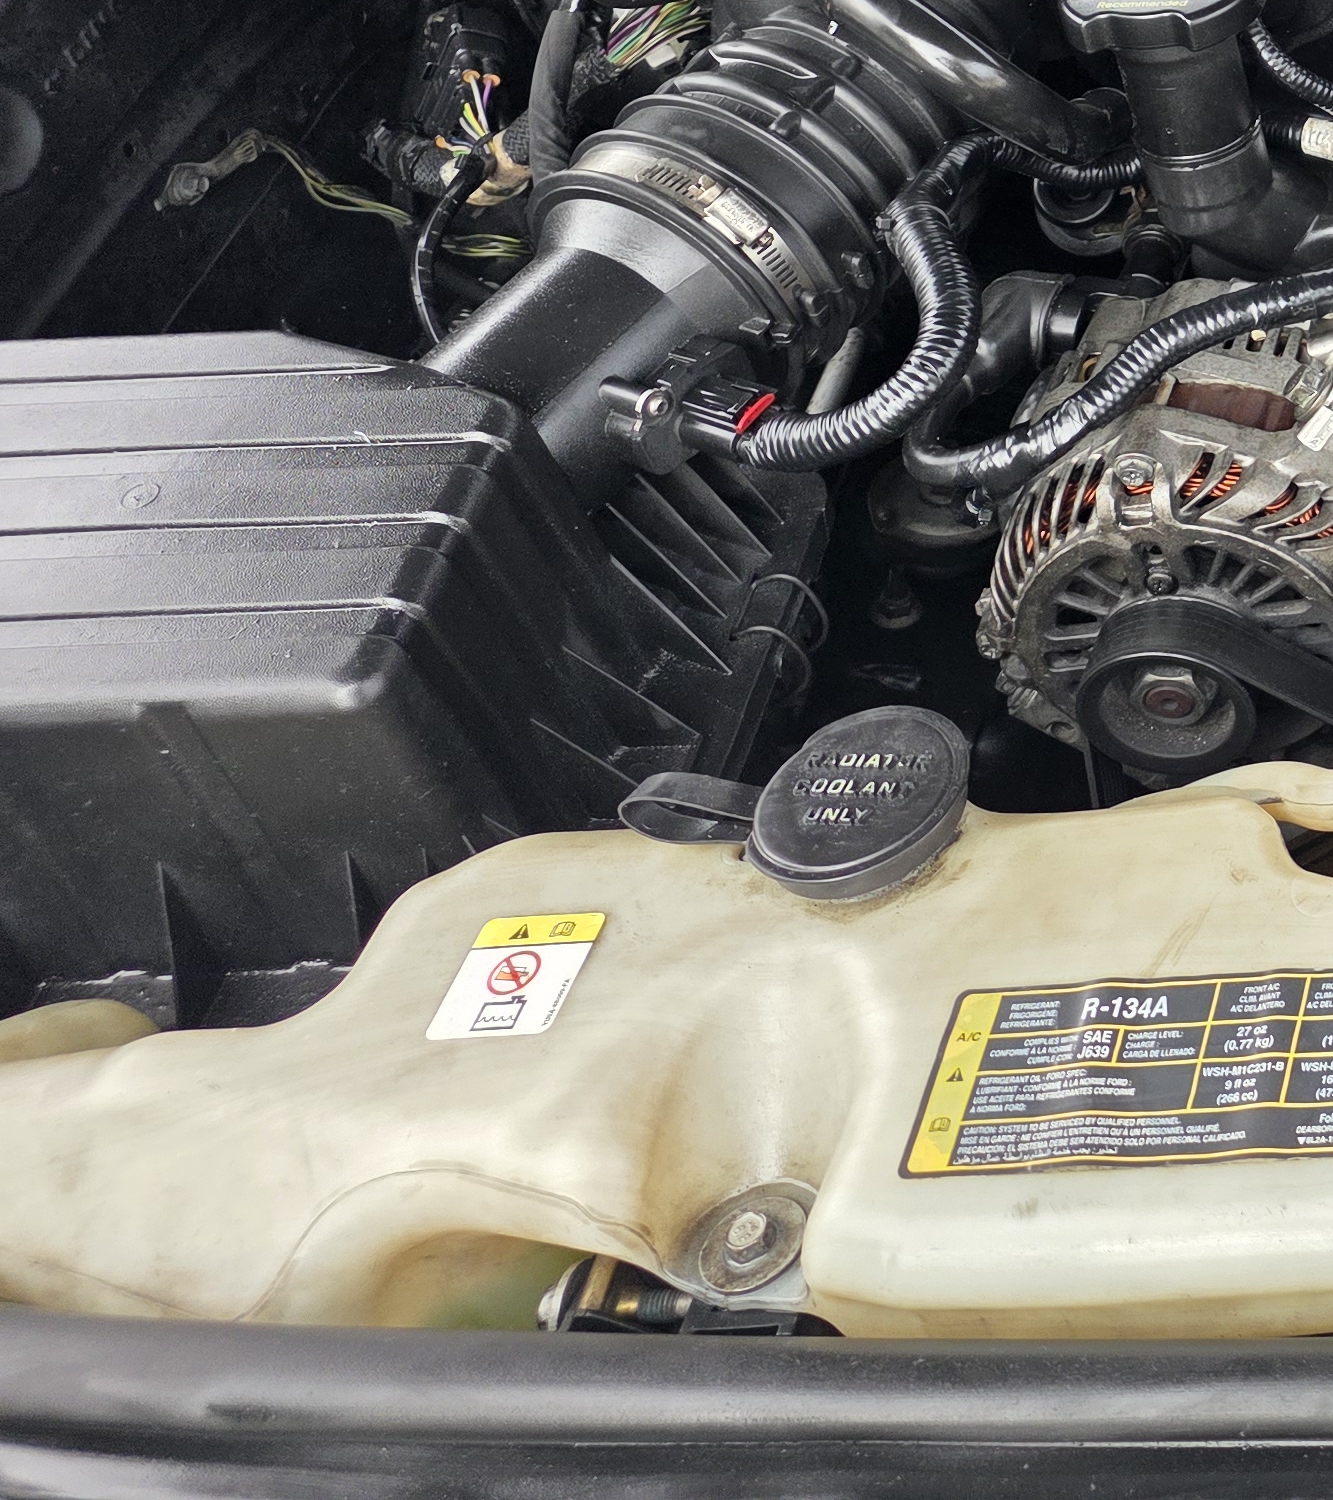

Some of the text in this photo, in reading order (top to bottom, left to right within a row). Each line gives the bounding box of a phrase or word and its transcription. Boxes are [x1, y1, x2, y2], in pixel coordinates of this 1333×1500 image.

[1096, 0, 1188, 10] Recommended
[1081, 996, 1168, 1020] R-134A
[1230, 1001, 1285, 1012] A/C DELANTERO
[1307, 1001, 1318, 1009] A/C
[1128, 1032, 1157, 1040] CHARGE
[1237, 1025, 1267, 1036] 27 oz
[957, 1032, 981, 1042] A/C
[1083, 1030, 1112, 1043] SAE
[1224, 1035, 1274, 1053] (0.77 kg)
[1077, 1045, 1109, 1059] J639
[1203, 1062, 1284, 1077] WSH-M1C231-B
[1225, 1078, 1256, 1090] 9 fl oz
[1322, 1075, 1333, 1084] 16
[1217, 1089, 1258, 1105] (266 cc)
